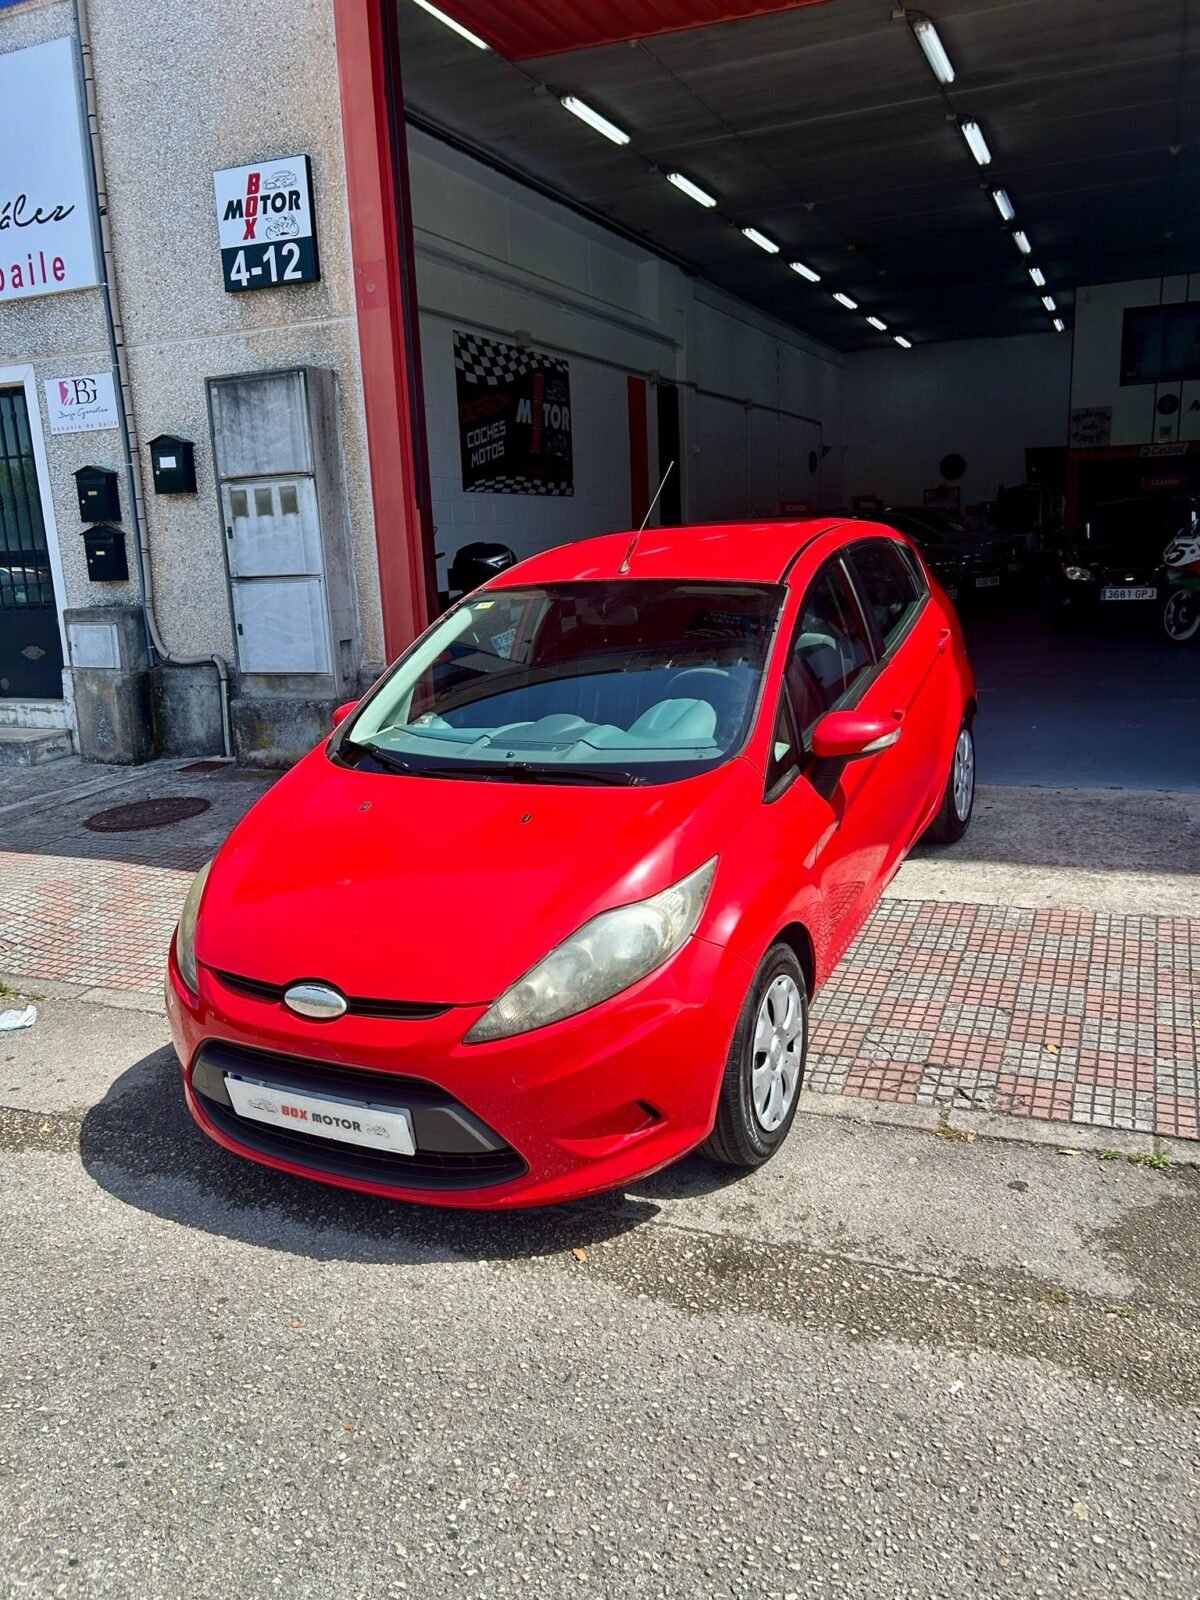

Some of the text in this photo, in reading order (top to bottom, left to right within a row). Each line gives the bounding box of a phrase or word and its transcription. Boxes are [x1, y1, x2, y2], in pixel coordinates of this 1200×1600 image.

[223, 190, 301, 221] MOTOR
[243, 172, 261, 240] BOX
[230, 242, 302, 286] 4-12
[515, 398, 570, 431] MOTOR
[467, 420, 507, 449] COCHES
[470, 441, 505, 469] MOTOS
[1108, 589, 1155, 599] 3681 GPJ
[281, 1104, 362, 1133] BOX MOTOR
